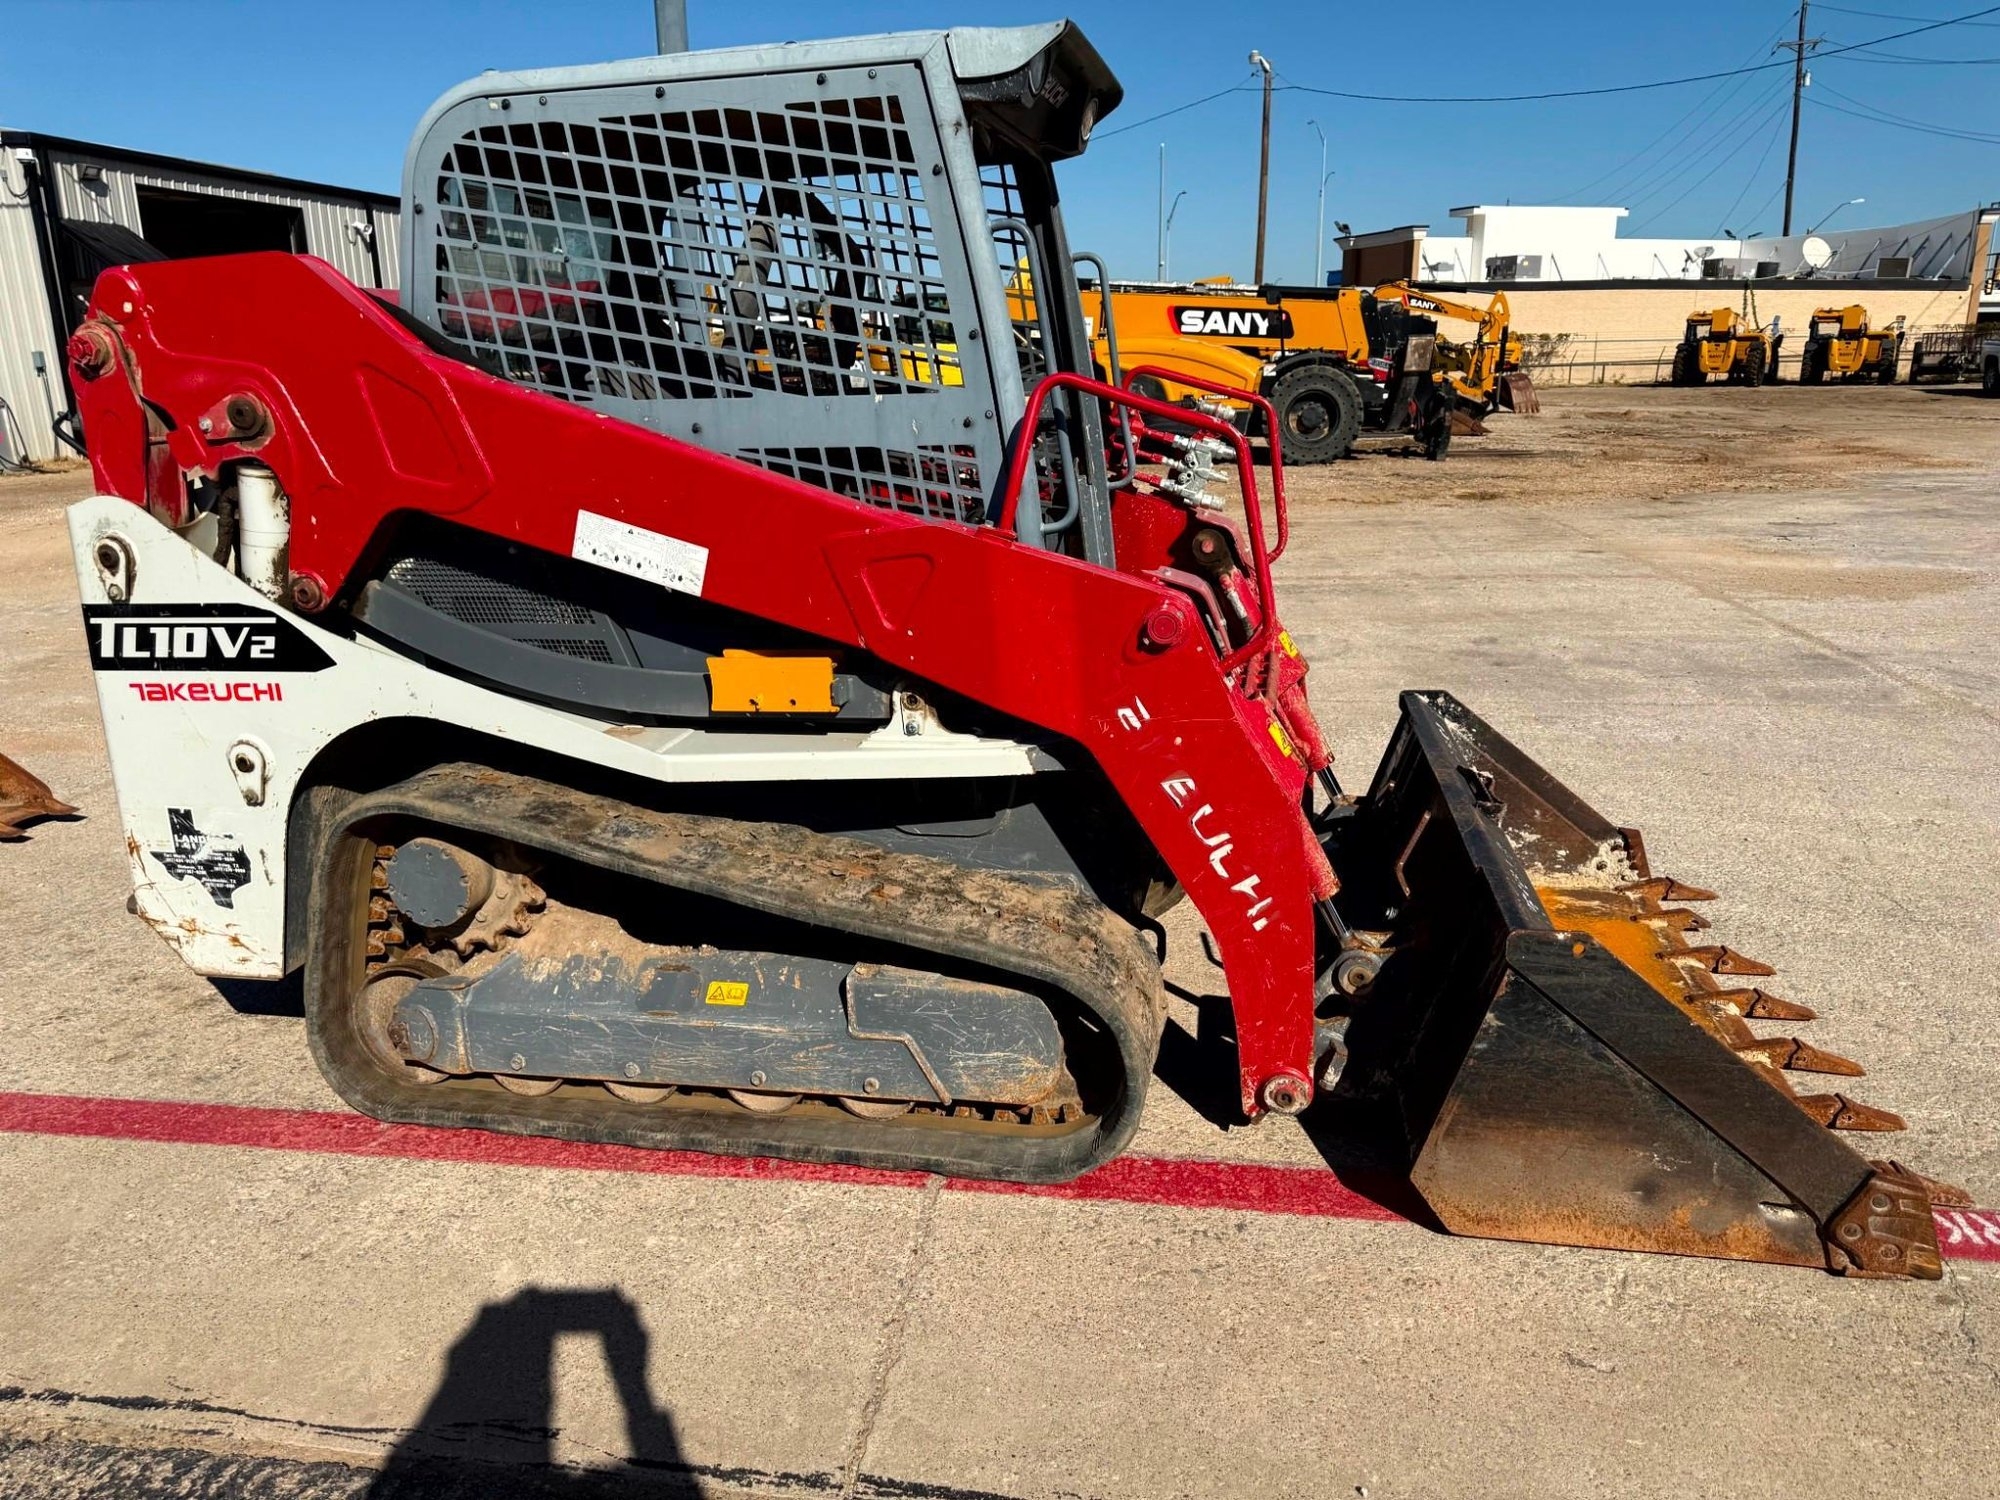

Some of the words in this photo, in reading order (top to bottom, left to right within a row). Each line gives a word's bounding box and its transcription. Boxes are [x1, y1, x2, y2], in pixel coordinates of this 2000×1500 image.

[1410, 298, 1436, 310] SANY
[1180, 309, 1269, 336] SANY
[90, 617, 277, 659] TL10V2
